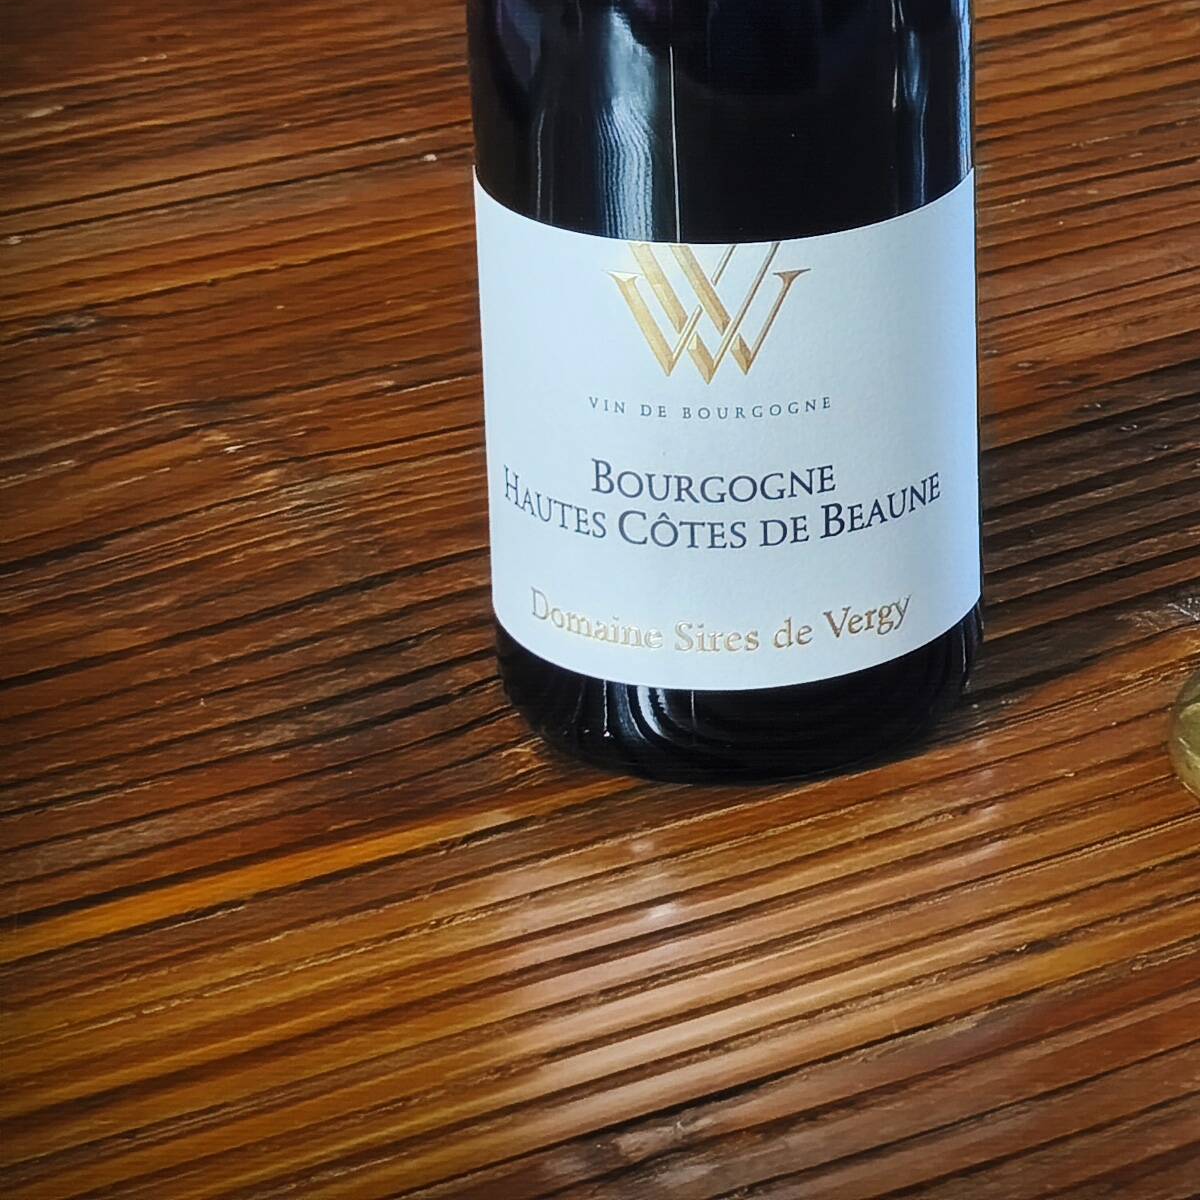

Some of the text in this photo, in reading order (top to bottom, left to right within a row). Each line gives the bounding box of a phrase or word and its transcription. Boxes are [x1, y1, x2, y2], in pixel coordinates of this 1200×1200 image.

[589, 396, 833, 420] VIN DE BOURGOGNE
[503, 464, 941, 549] HAUTES CÔTES DE BEAUNE
[591, 458, 836, 503] BOURGOGNE
[531, 587, 912, 652] Domaine Sires de Vergy
